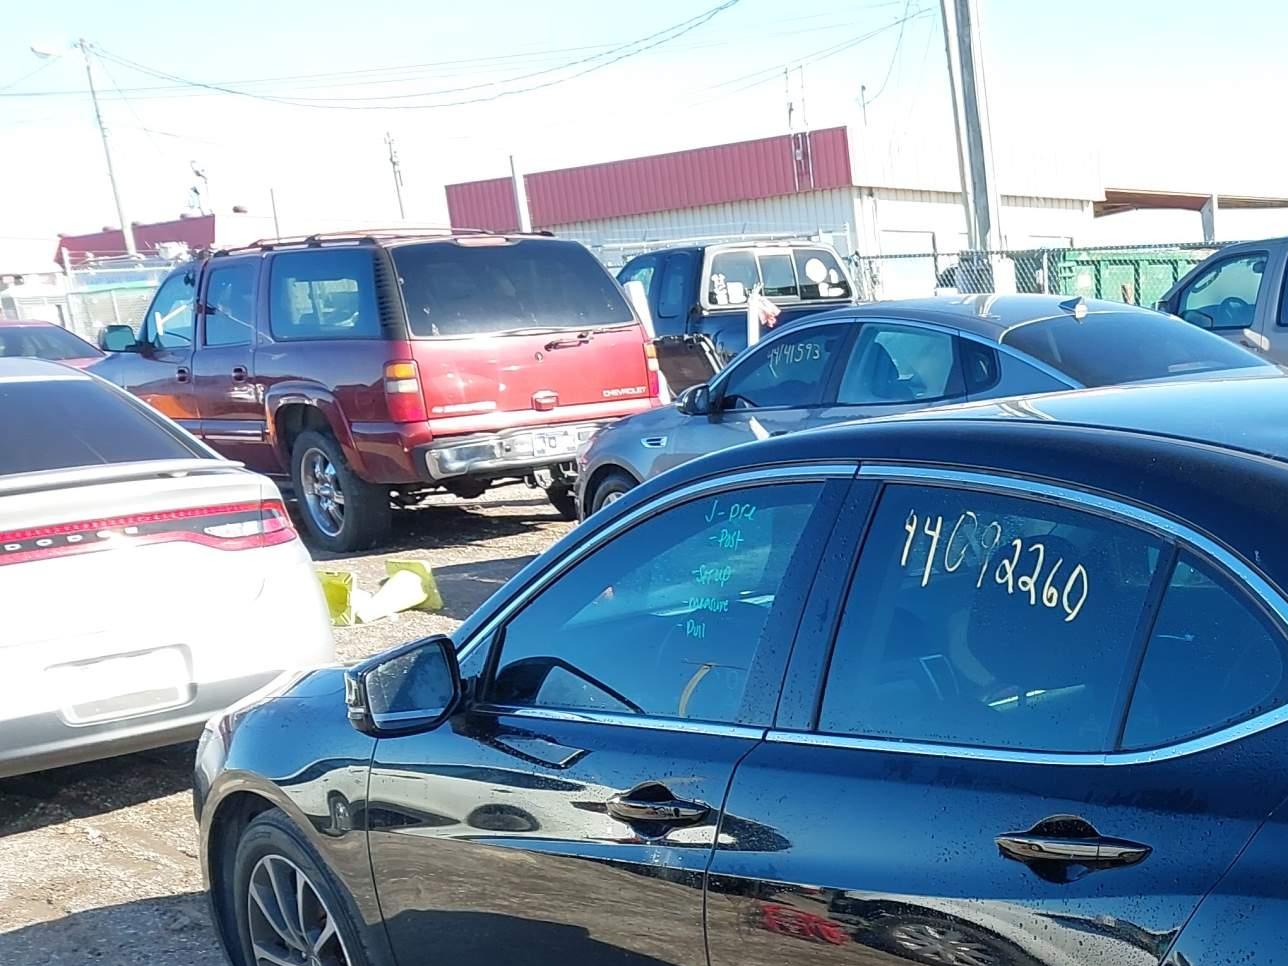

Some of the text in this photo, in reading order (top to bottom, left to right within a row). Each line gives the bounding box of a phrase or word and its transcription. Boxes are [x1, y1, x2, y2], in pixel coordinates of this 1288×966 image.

[602, 385, 647, 398] CHEVROLET
[4, 526, 139, 551] DOD
[900, 509, 1088, 621] 44092260
